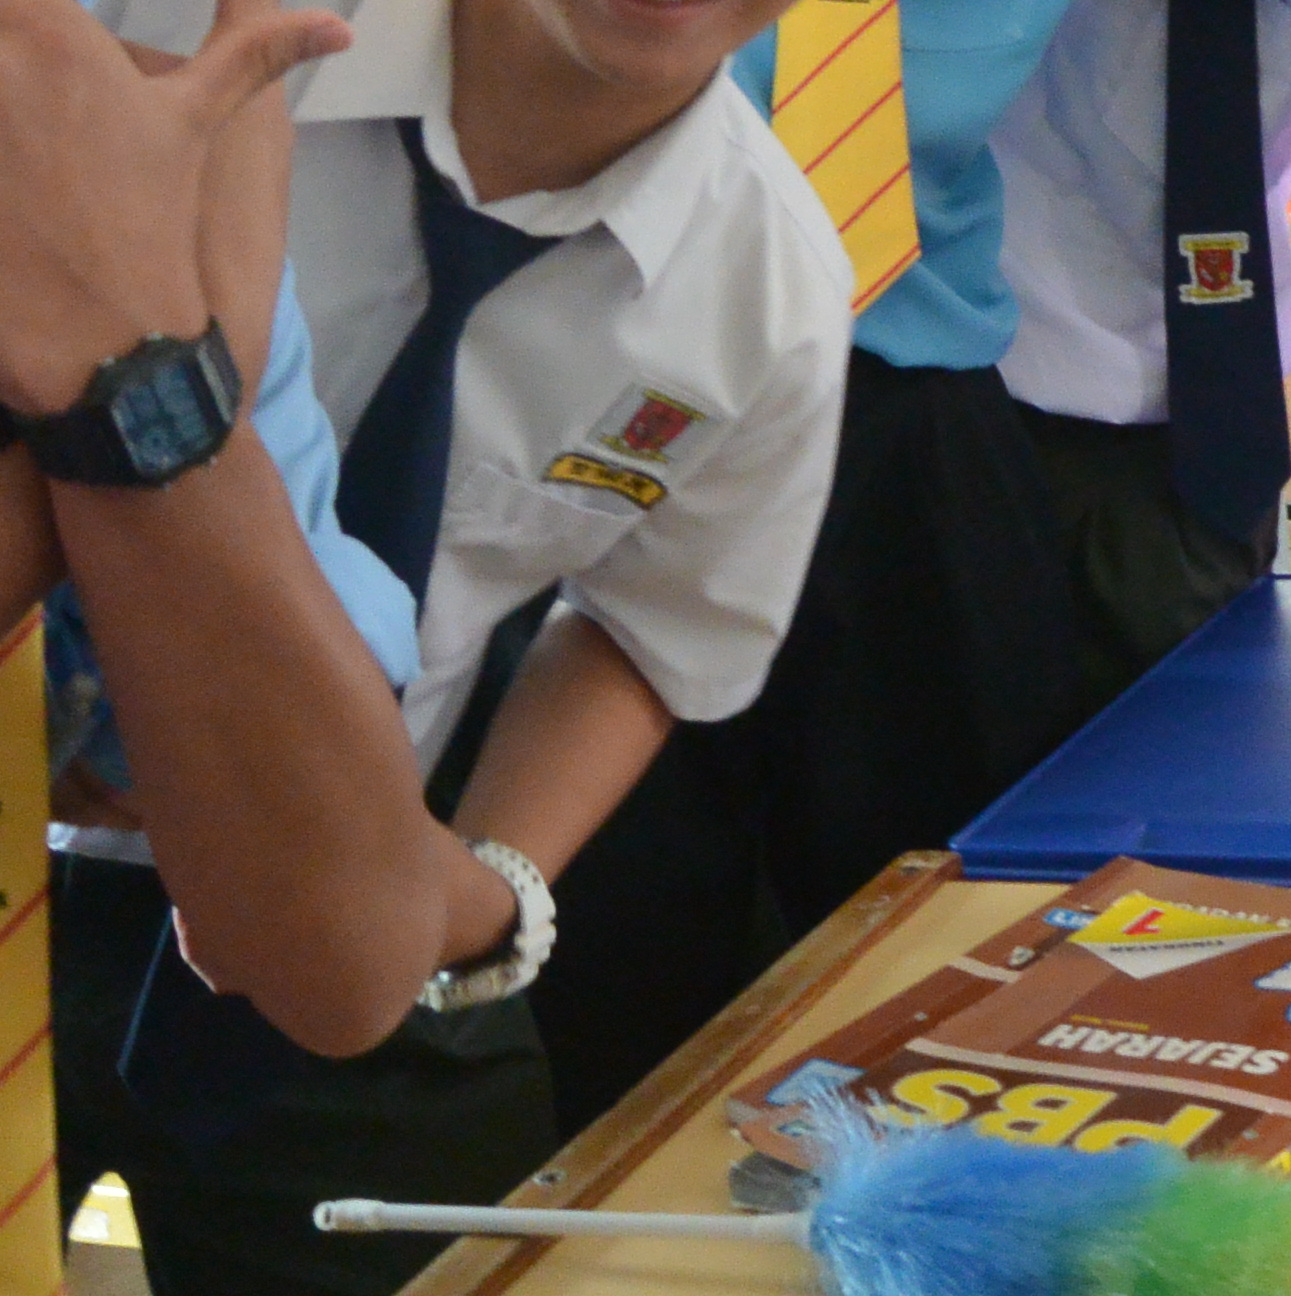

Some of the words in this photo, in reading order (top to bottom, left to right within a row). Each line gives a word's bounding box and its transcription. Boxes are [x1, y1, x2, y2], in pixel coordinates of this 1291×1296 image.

[1122, 907, 1166, 936] 1
[1037, 1023, 1290, 1076] SEJARAH
[884, 1068, 1224, 1154] PBS
